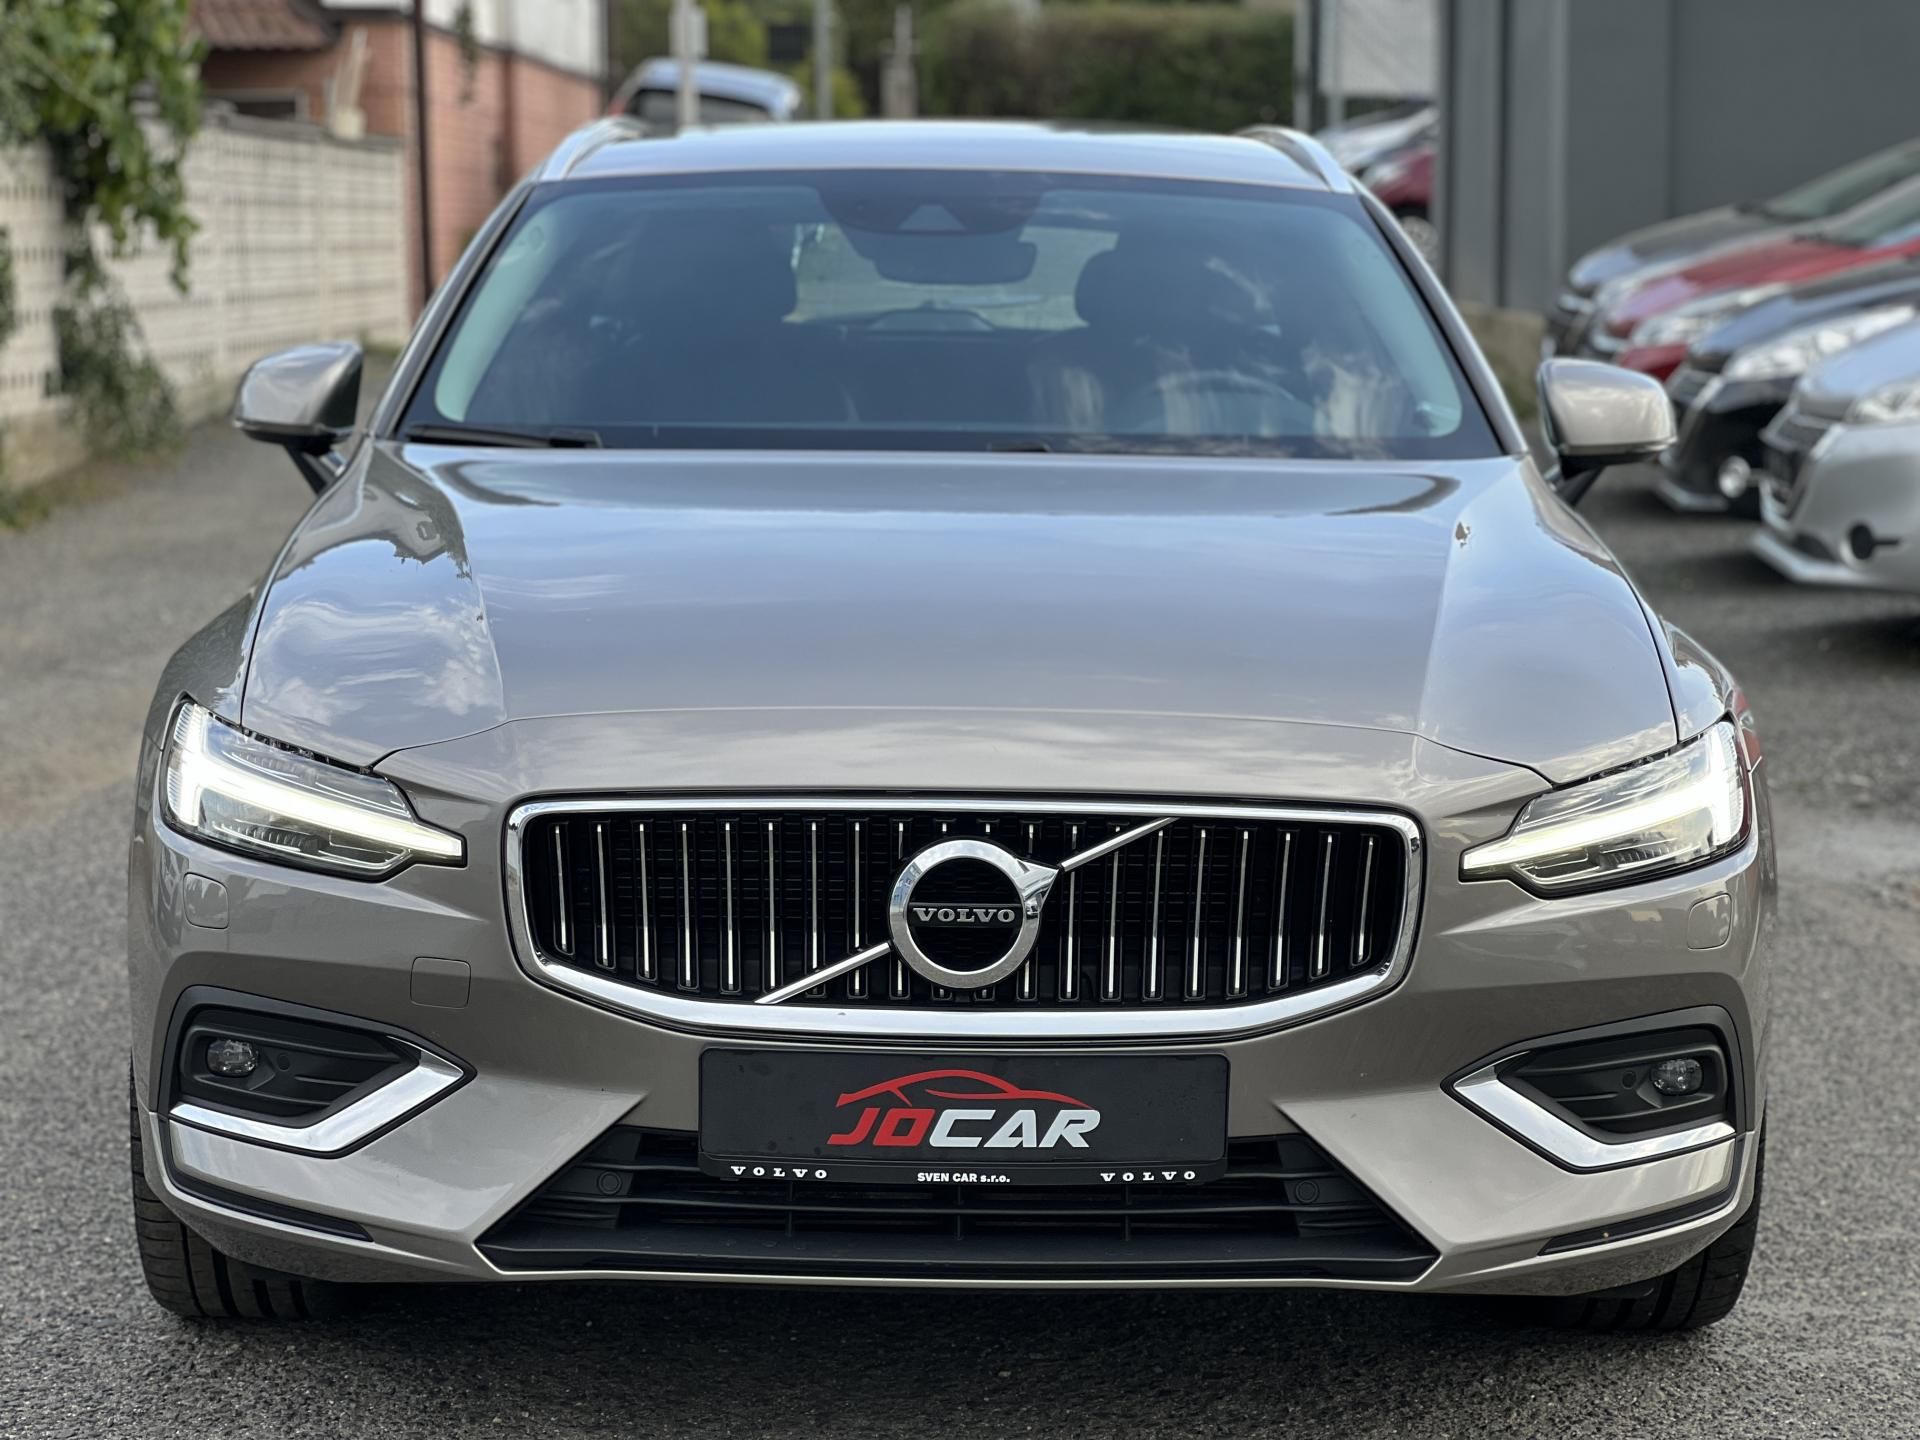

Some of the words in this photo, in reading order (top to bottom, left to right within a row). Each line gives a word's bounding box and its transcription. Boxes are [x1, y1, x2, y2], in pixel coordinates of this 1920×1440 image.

[913, 907, 1016, 923] VOLVO
[826, 1107, 1101, 1149] JOCAR
[730, 1165, 828, 1179] VOLVO
[917, 1172, 950, 1182] SVEN
[952, 1172, 978, 1183] CAR
[979, 1174, 1011, 1183] s.r.o.
[1099, 1170, 1196, 1182] VOLVO
